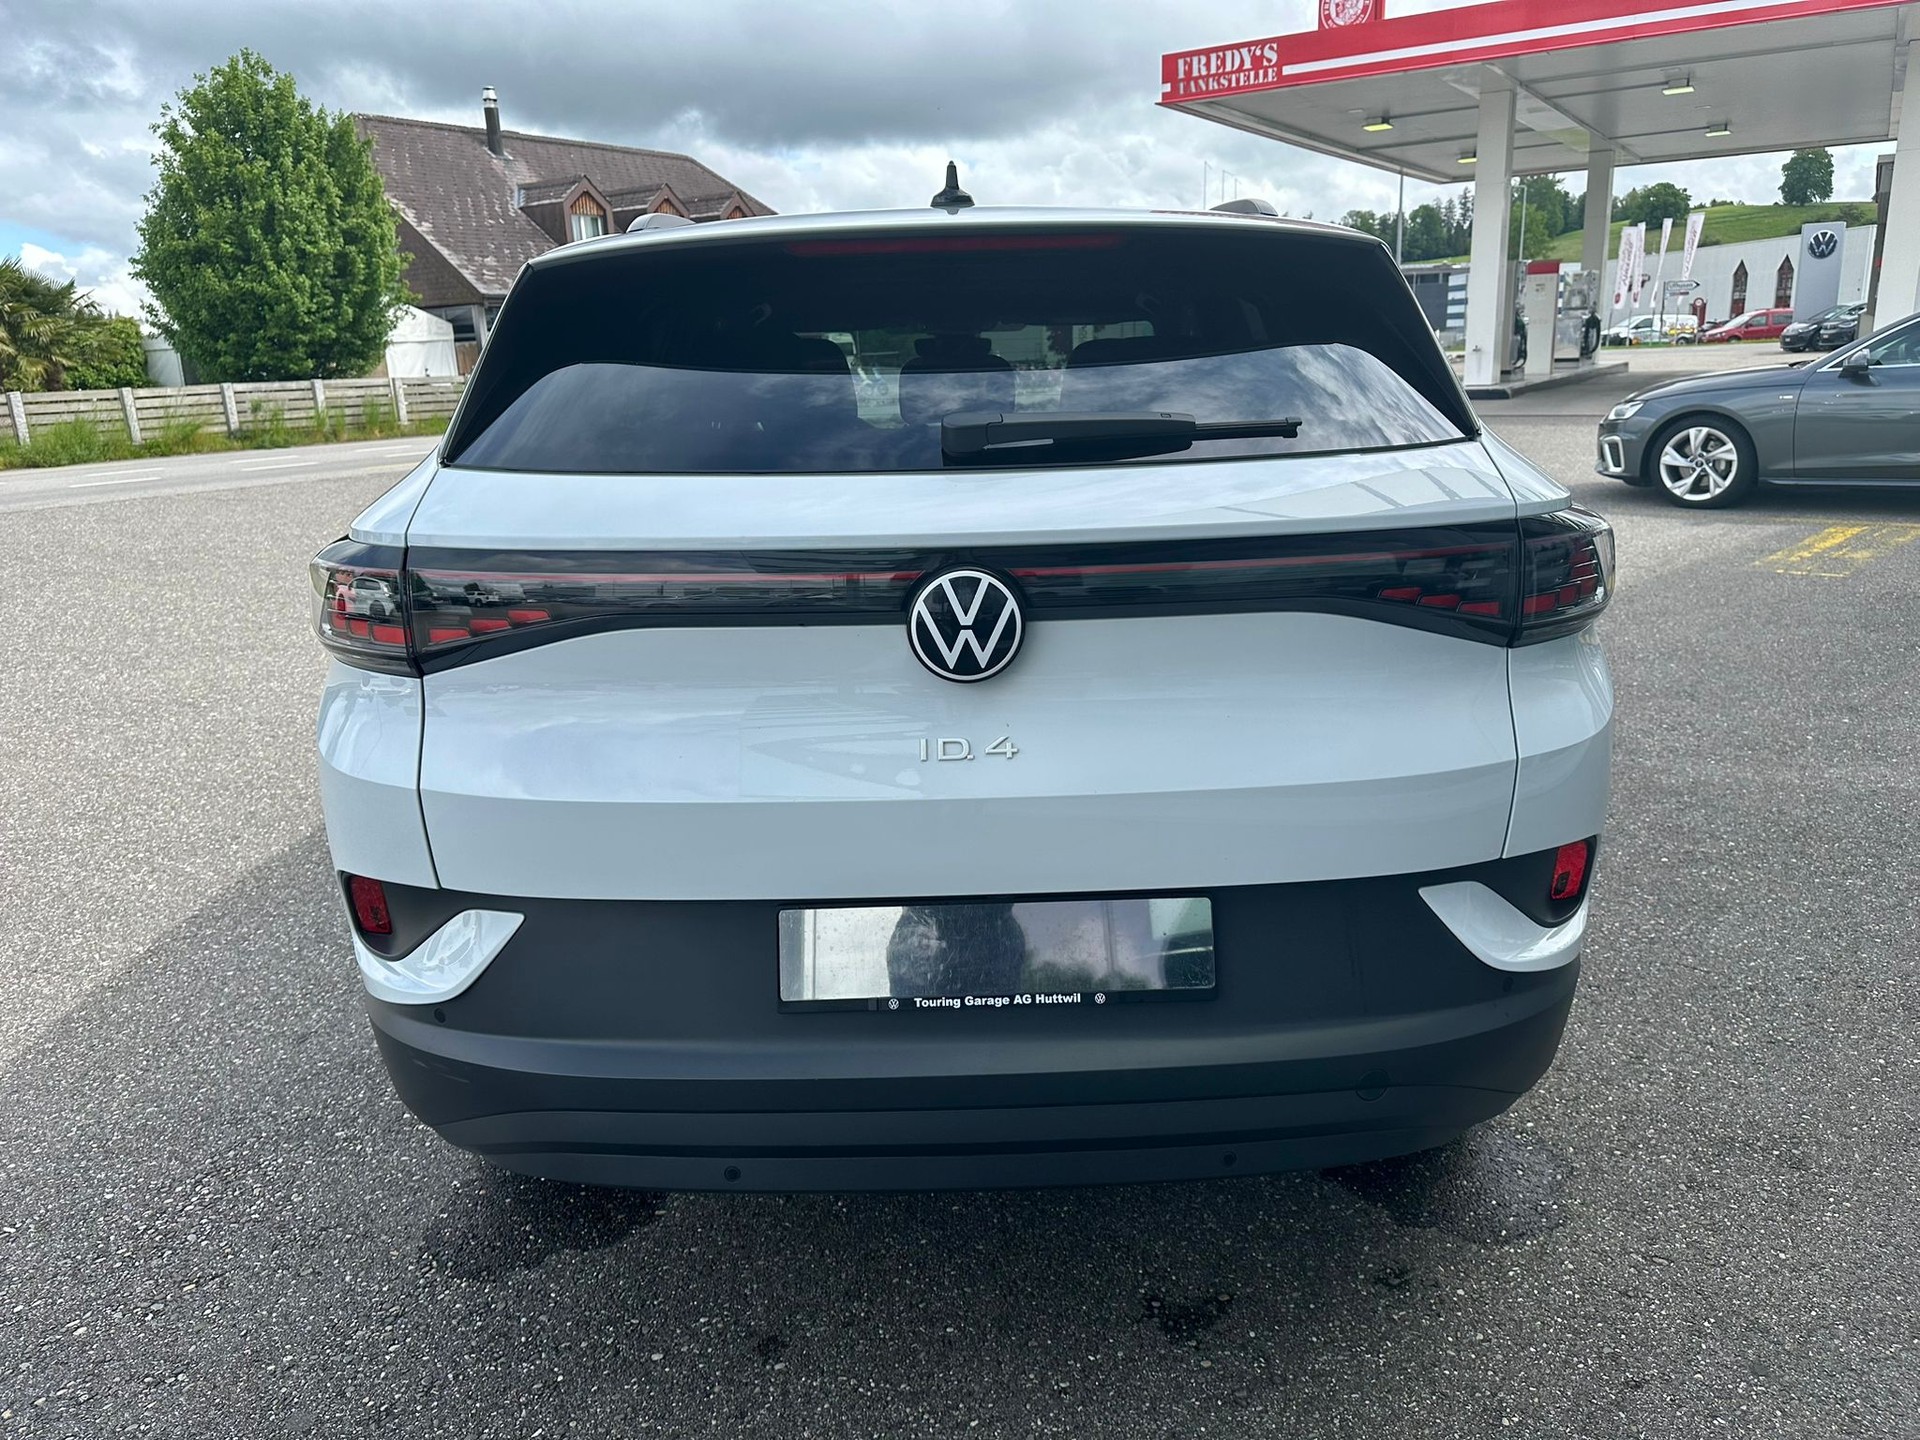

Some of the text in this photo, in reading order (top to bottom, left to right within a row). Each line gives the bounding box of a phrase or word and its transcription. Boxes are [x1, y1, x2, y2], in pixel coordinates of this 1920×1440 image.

[1179, 67, 1278, 95] TANKSTELLE
[912, 572, 1021, 680] VW
[919, 736, 1020, 762] ID.4
[914, 992, 1081, 1009] Touring Garage AG Huttwil
